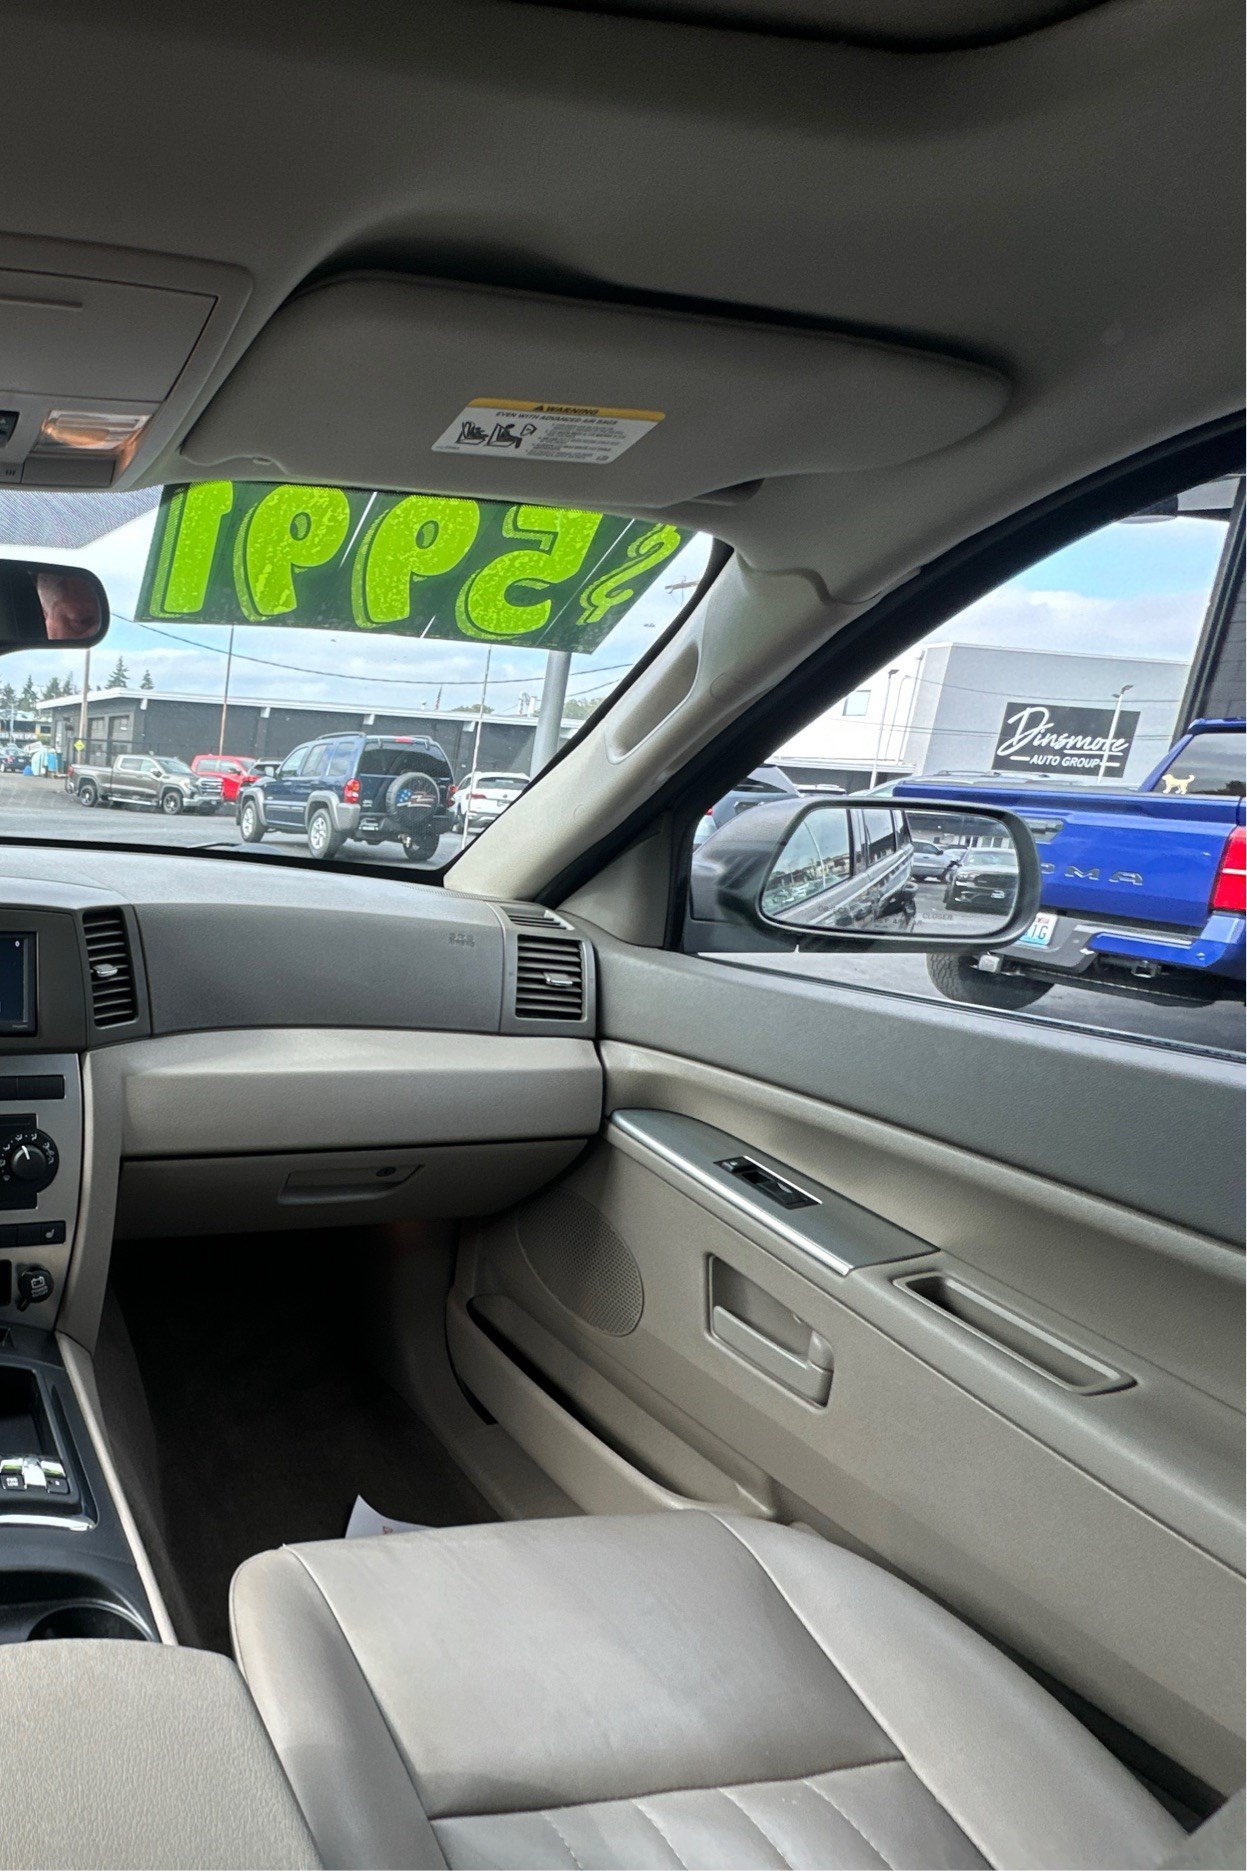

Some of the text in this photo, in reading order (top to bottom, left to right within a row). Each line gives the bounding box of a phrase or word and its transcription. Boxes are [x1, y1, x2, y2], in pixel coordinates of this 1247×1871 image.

[544, 405, 600, 416] WARNING
[996, 706, 1129, 756] Dinsmore
[1029, 754, 1101, 769] AUTO GROUP
